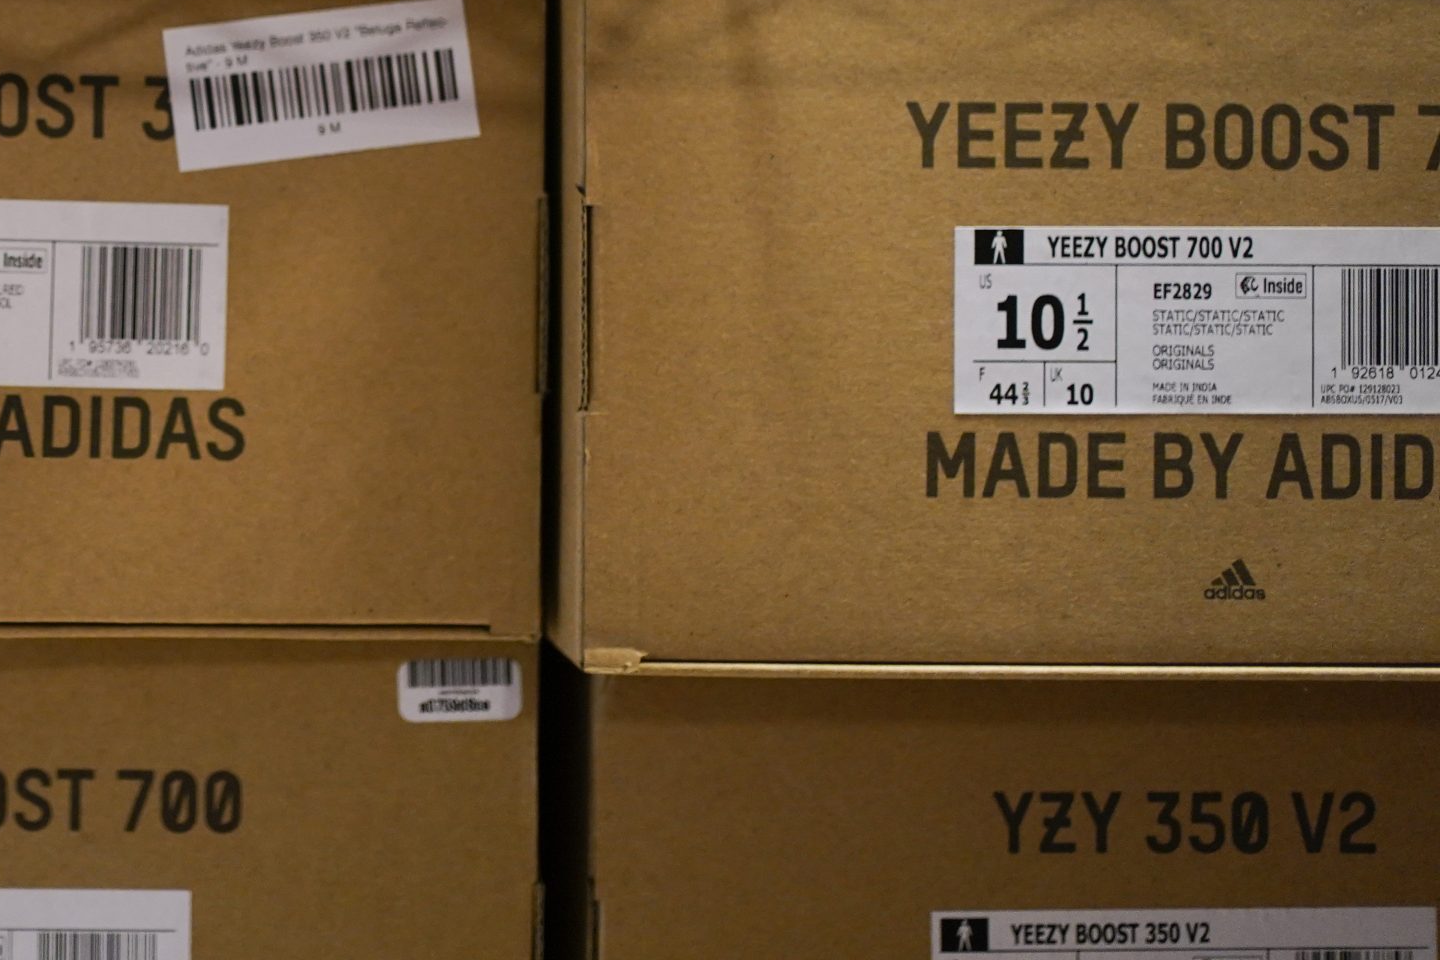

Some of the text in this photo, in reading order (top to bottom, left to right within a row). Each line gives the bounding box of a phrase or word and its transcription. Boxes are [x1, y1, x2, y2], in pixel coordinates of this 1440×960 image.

[906, 101, 1139, 170] YEEZY
[1165, 102, 1395, 172] BOOST
[1048, 236, 1254, 258] YEEZY BOOST 700 V2
[979, 273, 992, 289] US
[1153, 283, 1212, 299] EF2829
[1264, 278, 1303, 294] Inside
[997, 294, 1065, 350] 10
[1153, 345, 1214, 356] ORIGINALS
[980, 367, 985, 380] F
[1050, 368, 1062, 381] UK
[1153, 359, 1214, 370] ORIGINALS
[990, 383, 1018, 405] 44
[1067, 384, 1093, 405] 10
[926, 431, 1435, 500] MADE BY ADID
[1204, 585, 1266, 600] adidas
[118, 770, 243, 833] 700
[994, 791, 1377, 854] YZY 350 V2
[1011, 922, 1211, 945] YEEZY BOOST 350 V2
